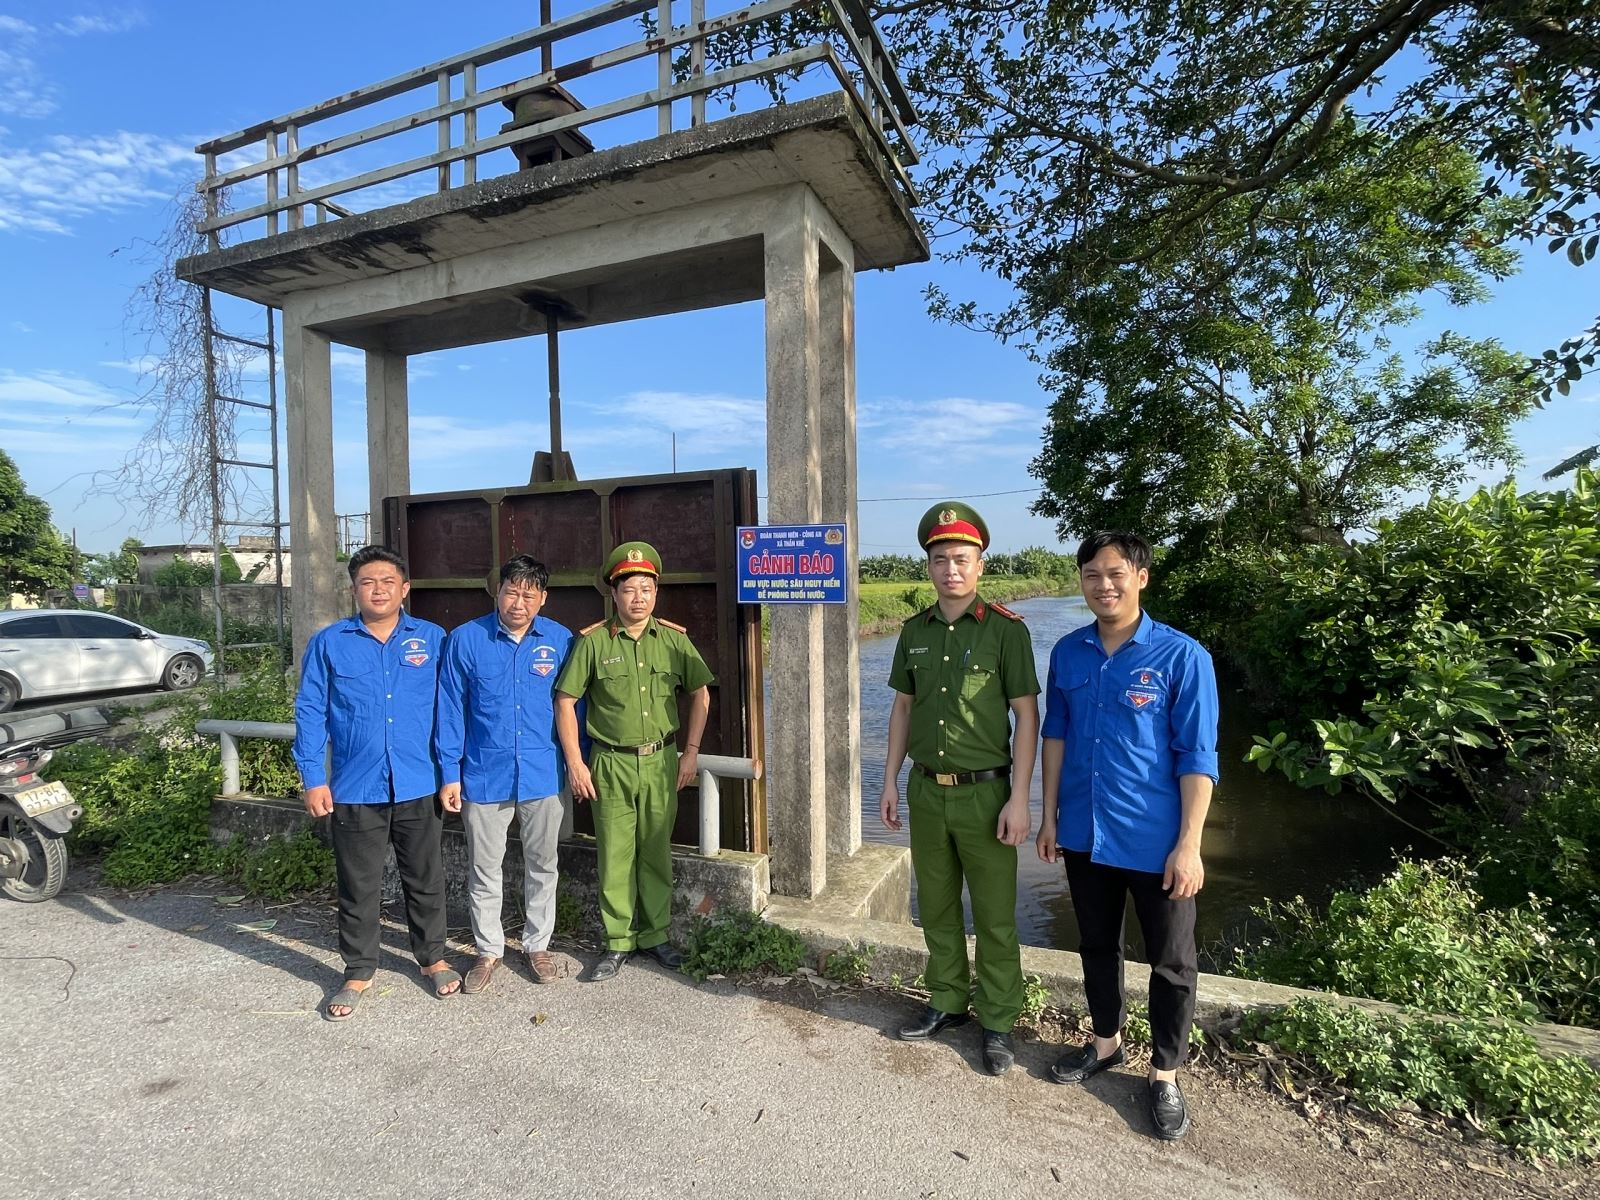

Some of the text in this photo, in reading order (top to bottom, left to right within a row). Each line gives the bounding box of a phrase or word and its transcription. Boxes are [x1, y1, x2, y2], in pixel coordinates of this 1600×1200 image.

[802, 530, 814, 538] CÔNG
[749, 549, 834, 575] CẢNH BÁO
[743, 580, 756, 588] KHU
[757, 580, 770, 589] VỰC
[771, 578, 788, 588] NƯỚC
[790, 578, 803, 588] SÂU
[804, 580, 822, 588] NGUY
[768, 590, 789, 599] PHÒNG
[807, 590, 825, 599] NƯỚC
